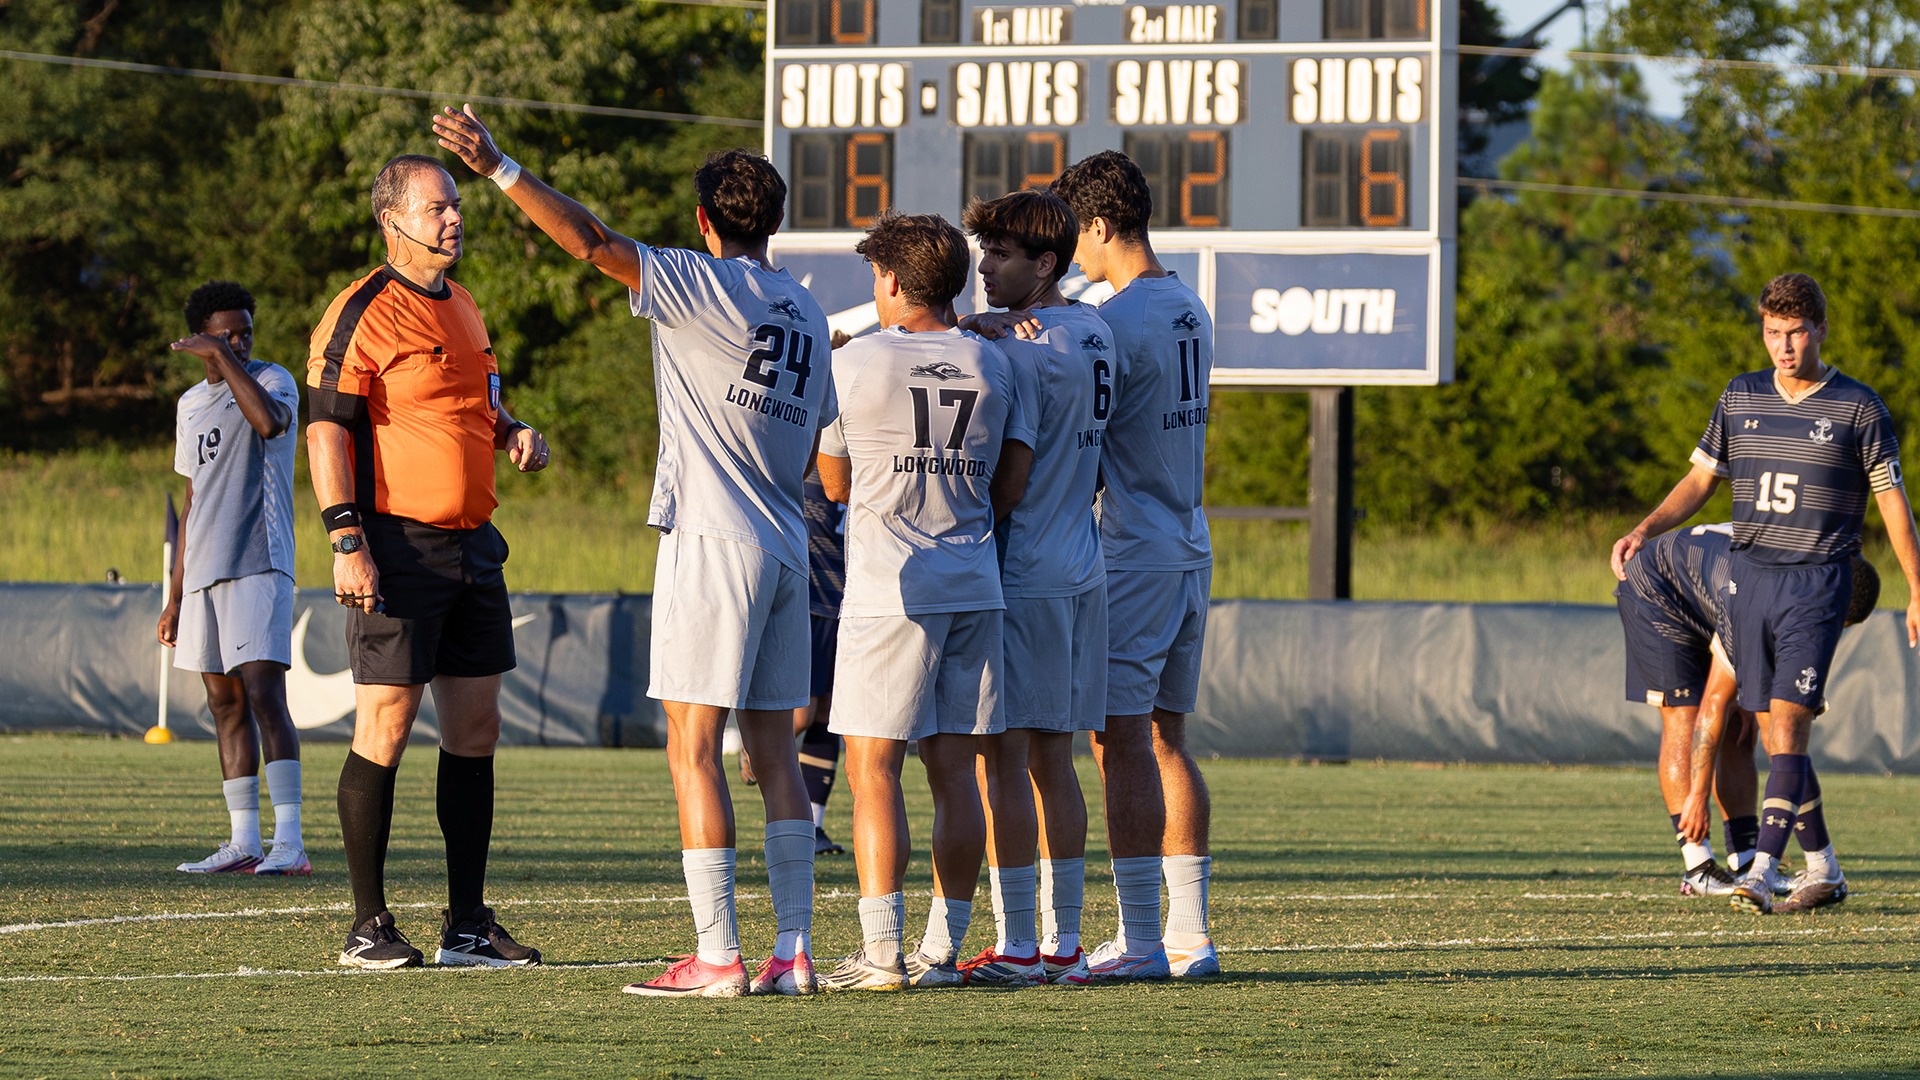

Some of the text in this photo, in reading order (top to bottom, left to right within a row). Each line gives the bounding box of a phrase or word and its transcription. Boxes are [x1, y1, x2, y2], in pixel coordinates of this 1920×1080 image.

[1012, 7, 1063, 45] HALF
[1166, 5, 1217, 43] HALF
[781, 63, 905, 128] SHOTS
[956, 61, 1079, 127] SAVES
[1116, 59, 1240, 125] SAVES
[1293, 57, 1422, 124] SHOTS
[846, 133, 889, 228] 6
[1181, 130, 1225, 227] 2
[1360, 130, 1405, 227] 6
[1250, 286, 1396, 336] SOUTH
[741, 323, 814, 400] 24
[1092, 359, 1112, 422] 6
[1176, 337, 1201, 403] 11
[725, 383, 808, 428] LONGWOOD
[906, 386, 981, 451] 17
[196, 425, 223, 467] 19
[893, 455, 986, 478] LONGWOOD
[1755, 471, 1799, 514] 15
